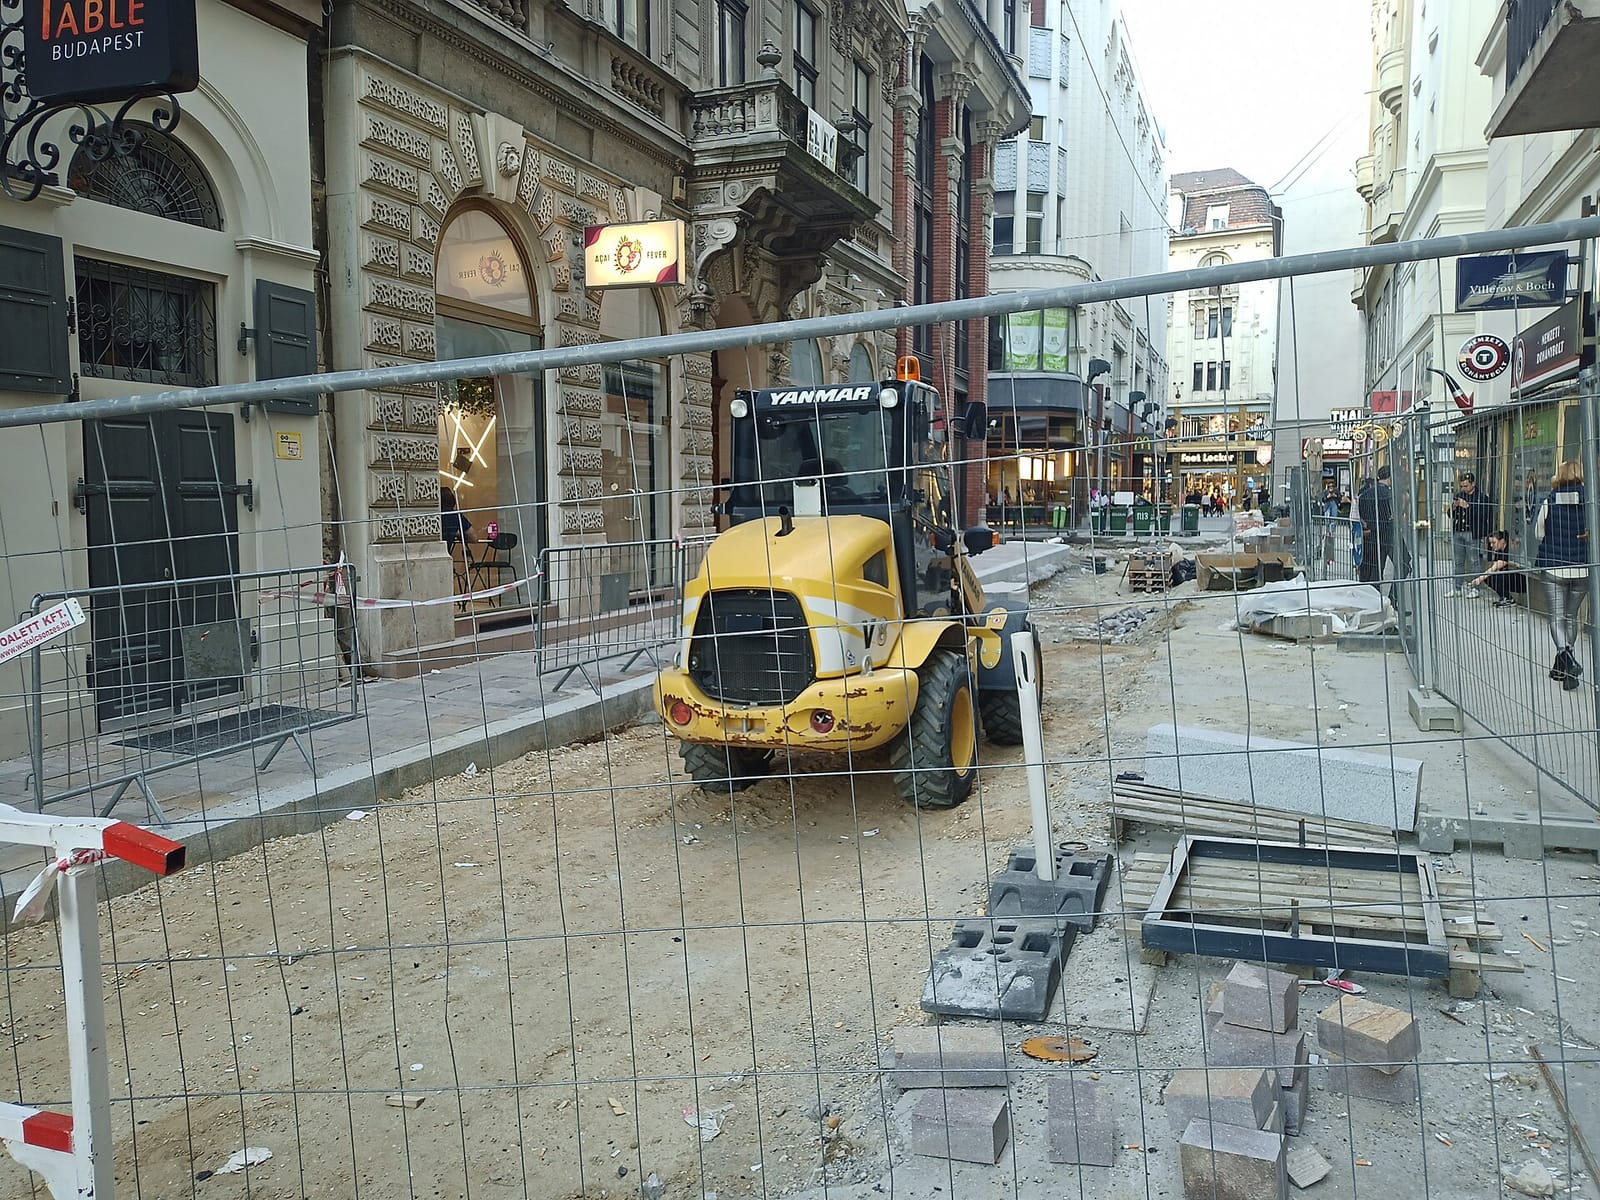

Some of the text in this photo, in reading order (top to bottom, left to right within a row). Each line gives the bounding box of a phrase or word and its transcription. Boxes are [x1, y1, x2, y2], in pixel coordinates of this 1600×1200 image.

[52, 31, 144, 61] BUDAPEST
[594, 250, 667, 264] AÇAI FEVER
[1470, 283, 1514, 295] Villeroy
[1526, 280, 1555, 291] Boch
[1468, 336, 1503, 348] NEMZETI
[1541, 325, 1561, 346] NEMZETI
[770, 386, 872, 406] YANMAR
[1331, 410, 1362, 423] THAI
[1181, 452, 1235, 462] Foot Locker
[42, 608, 67, 627] KFT.
